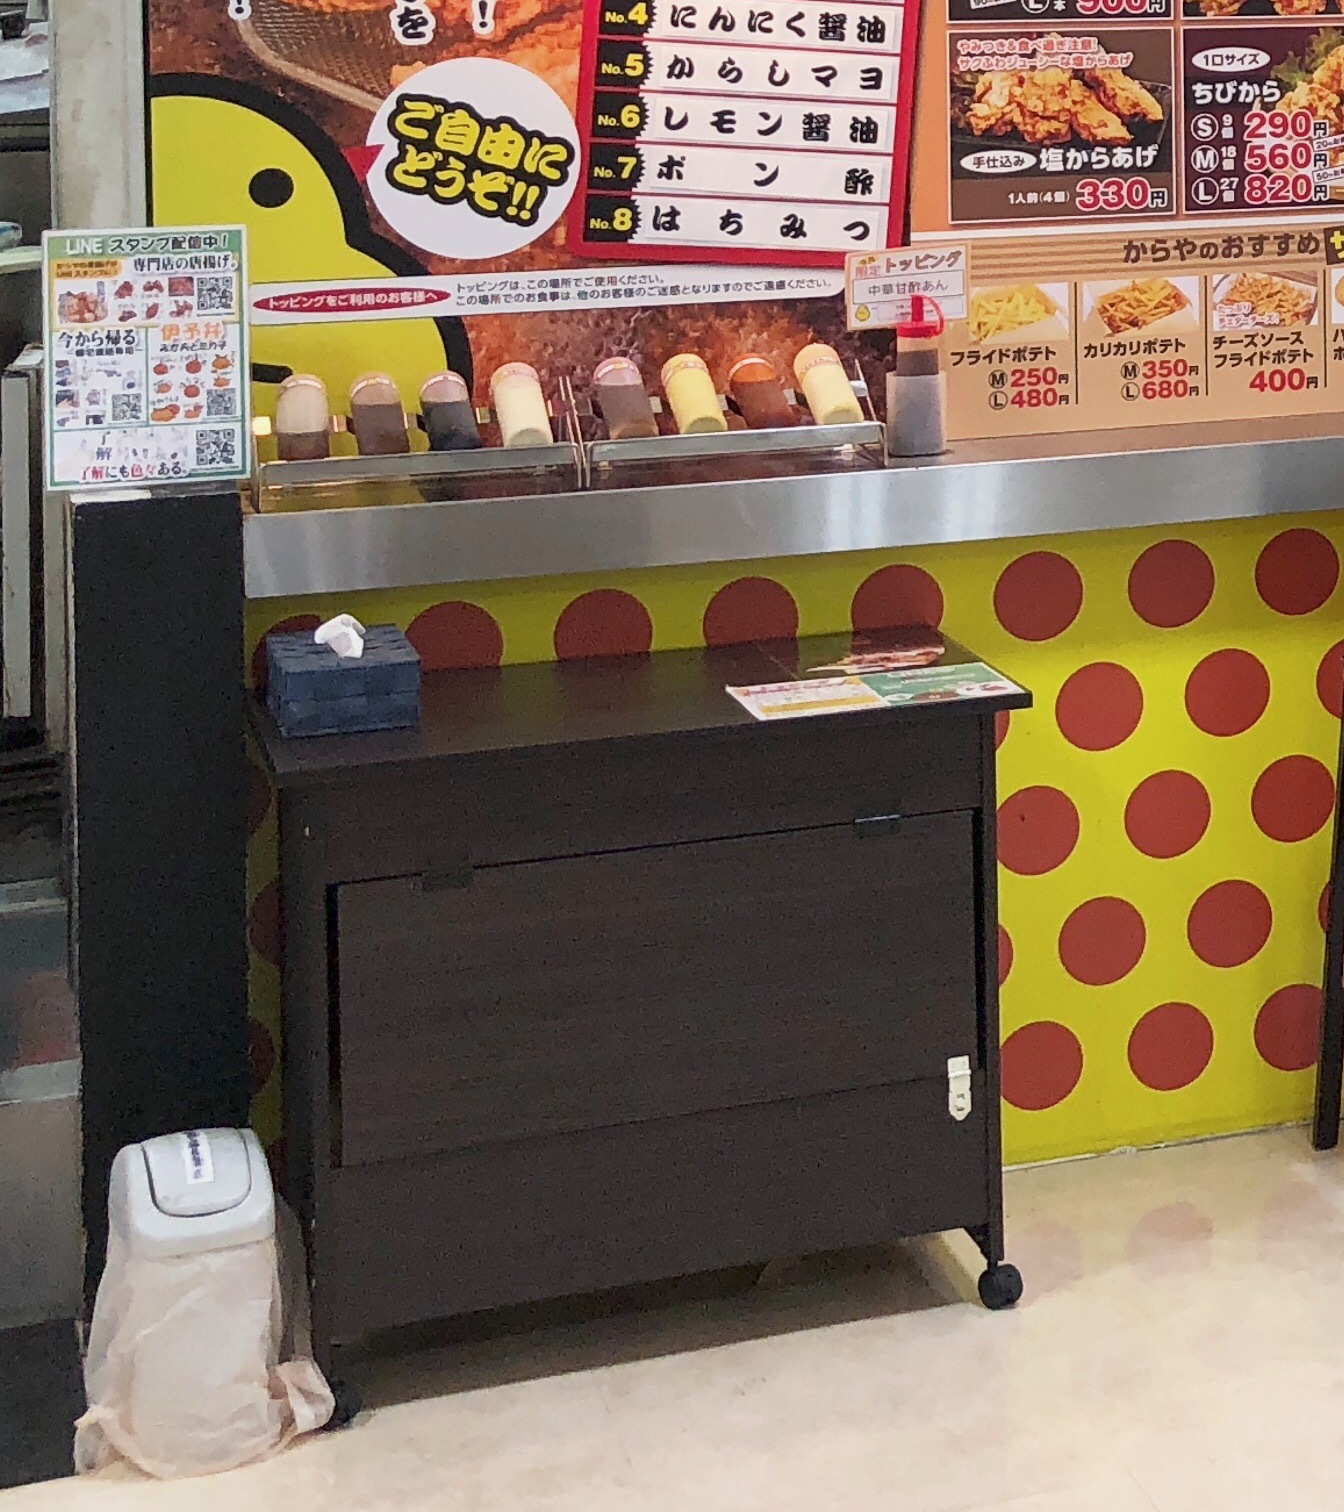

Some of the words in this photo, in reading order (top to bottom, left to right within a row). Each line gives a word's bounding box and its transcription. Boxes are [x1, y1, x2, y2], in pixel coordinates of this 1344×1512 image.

[605, 2, 648, 25] No.4
[670, 5, 886, 43] にんにく醤油
[601, 54, 644, 76] No.5
[667, 54, 883, 90] からしマヨ
[1191, 79, 1282, 106] ちびから
[597, 104, 641, 128] No.6
[1244, 110, 1329, 139] 290円
[394, 100, 568, 180] ご自由に
[1039, 145, 1159, 172] 塩からあげ
[1245, 142, 1329, 171] 560円
[593, 157, 637, 179] No.7
[657, 156, 874, 196] ポン酢
[1244, 173, 1329, 203] 820円
[1076, 179, 1167, 211] 330円
[589, 208, 633, 231] No.8
[652, 205, 870, 240] はちみつ
[66, 237, 102, 253] LINE
[886, 250, 962, 273] トッピング
[58, 330, 136, 347] 今から帰る
[1084, 338, 1186, 359] カリカリポテト
[1212, 331, 1305, 349] チーズソース
[950, 346, 1057, 365] フライドポテト
[1213, 349, 1315, 368] フライドポテト
[1010, 366, 1069, 389] 250円
[1142, 359, 1199, 380] 350円
[1249, 369, 1318, 394] 400円
[1010, 388, 1069, 410] 480円
[1142, 379, 1199, 401] 680円
